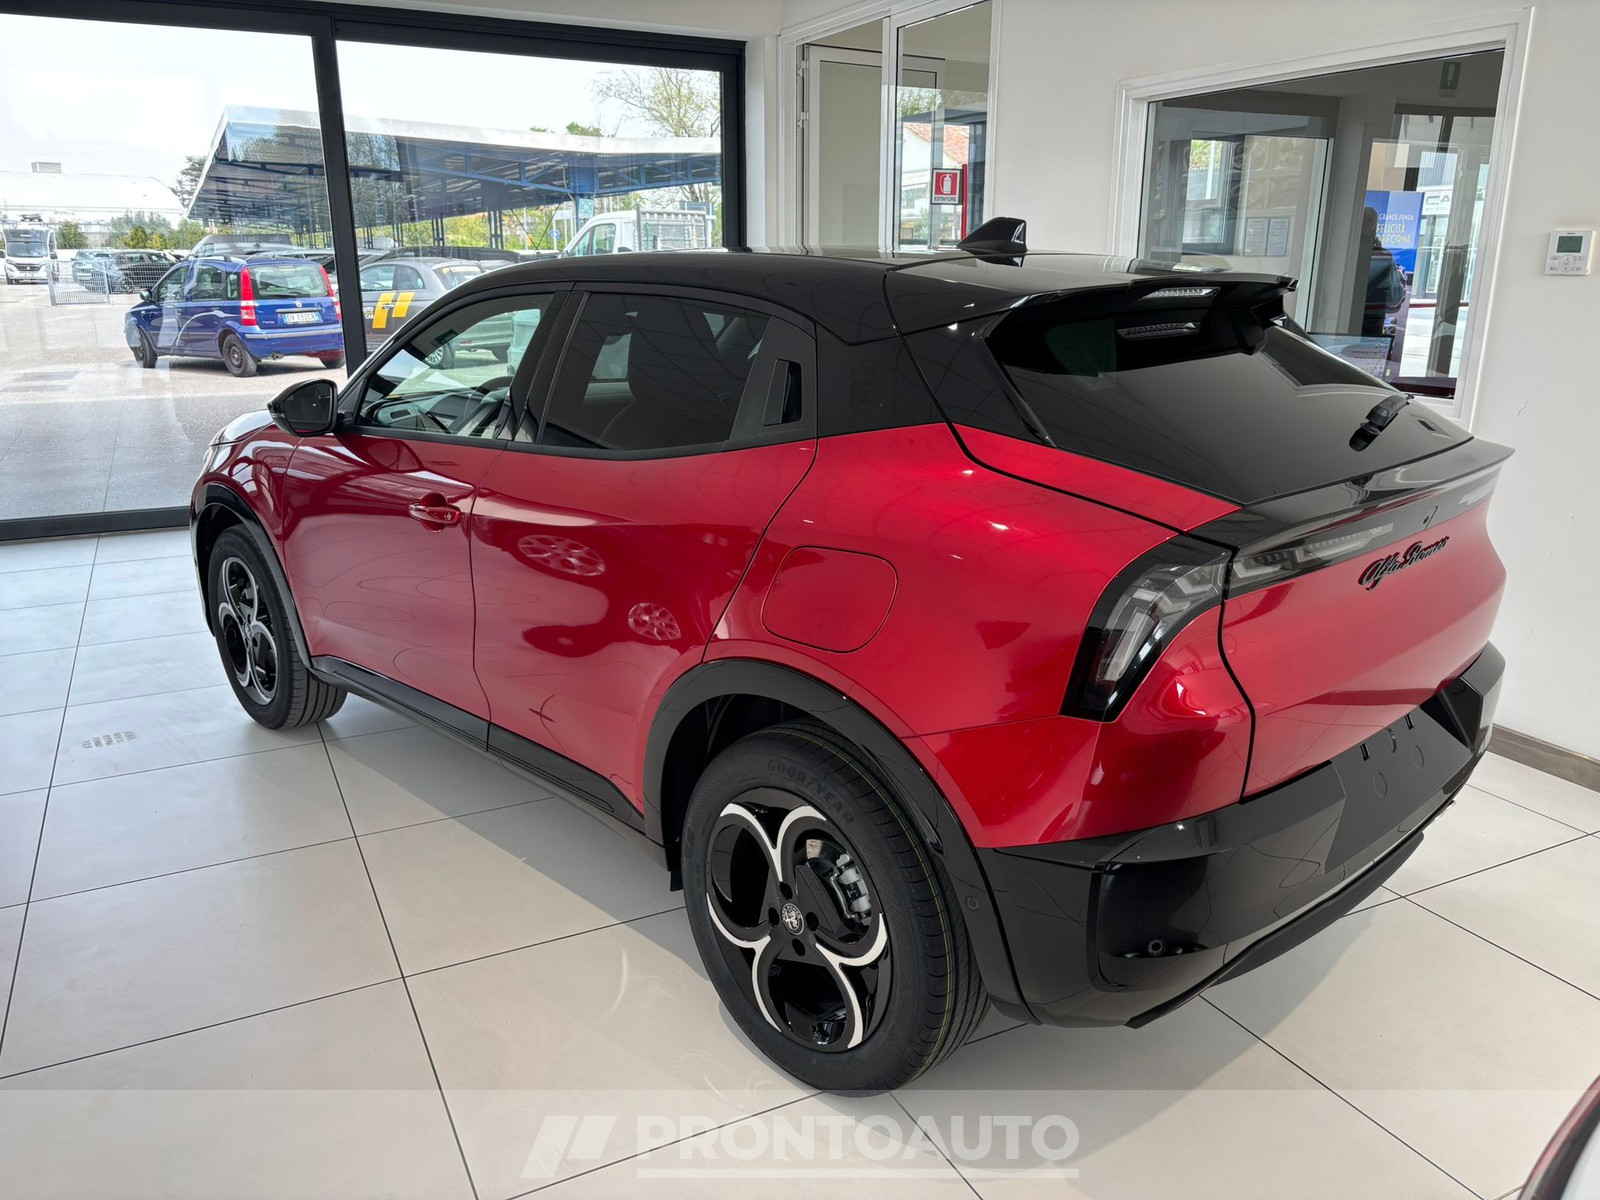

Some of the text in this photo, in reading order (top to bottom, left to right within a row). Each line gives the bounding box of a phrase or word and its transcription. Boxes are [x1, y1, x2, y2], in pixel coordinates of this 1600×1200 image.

[1376, 221, 1406, 234] FELICITÀ
[1379, 212, 1415, 221] GRANDE PANDA
[1357, 535, 1450, 591] Alfa Romeo
[768, 760, 856, 824] GOODYEAR
